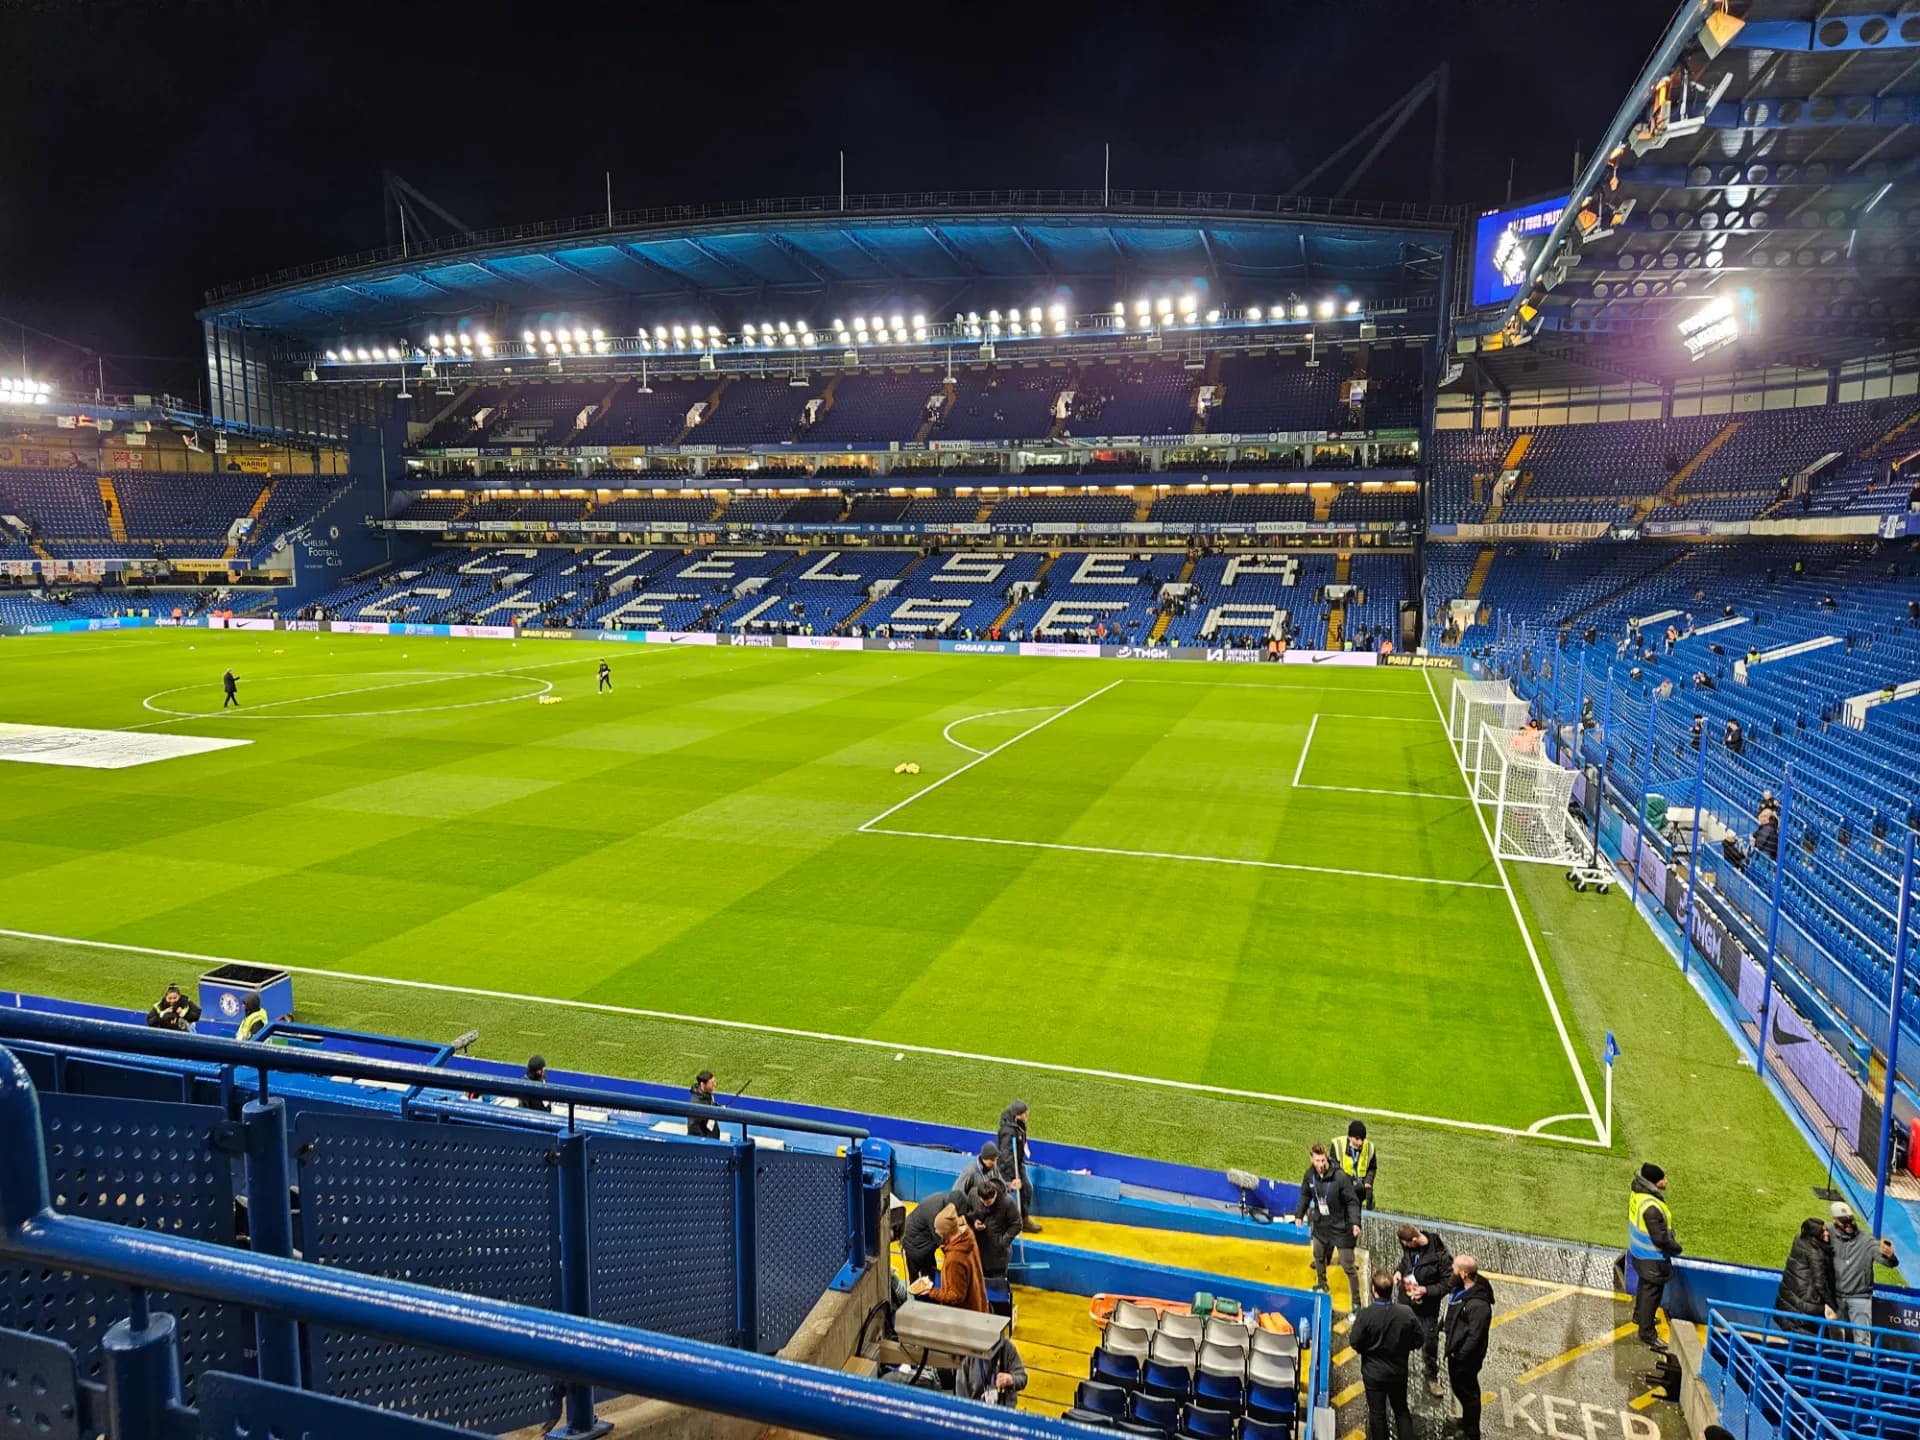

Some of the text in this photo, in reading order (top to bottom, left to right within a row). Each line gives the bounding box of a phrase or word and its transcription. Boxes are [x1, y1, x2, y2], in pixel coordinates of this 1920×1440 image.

[1257, 522, 1295, 531] HASTINGS
[1482, 524, 1598, 537] DROGBA LEGEND
[810, 638, 841, 649] trivago
[897, 641, 915, 650] MSC
[954, 643, 1006, 653] OMAN AIR
[1133, 647, 1168, 659] TMGM
[1225, 655, 1260, 663] ATHLETE
[1388, 655, 1412, 666] PARI
[1692, 906, 1722, 964] TMGM
